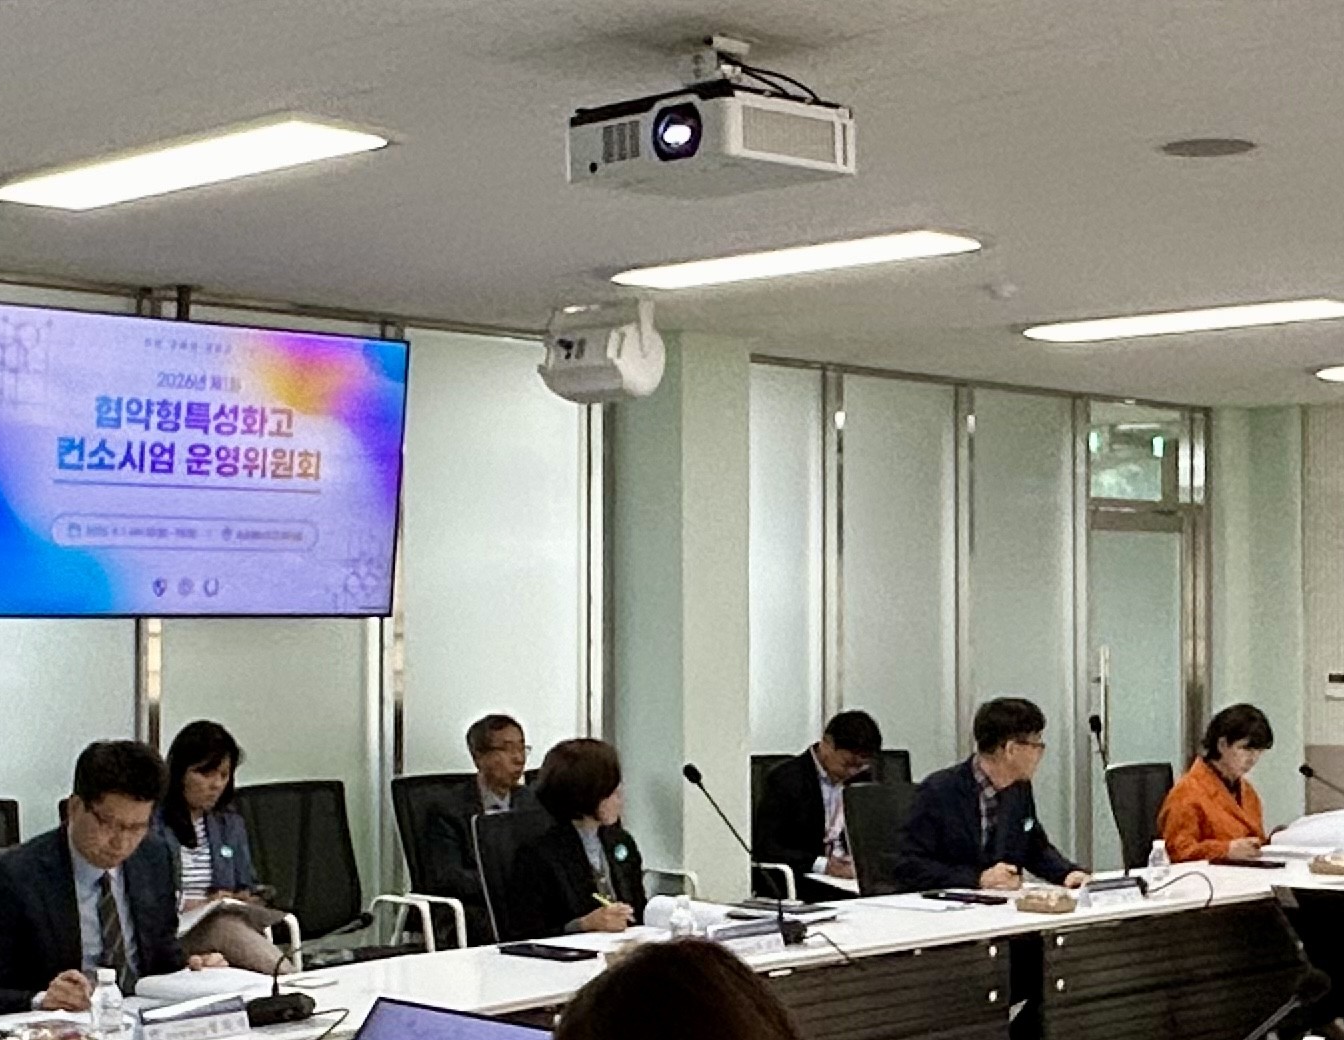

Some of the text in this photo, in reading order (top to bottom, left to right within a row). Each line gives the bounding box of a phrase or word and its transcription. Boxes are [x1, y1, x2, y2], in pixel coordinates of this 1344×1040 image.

[94, 395, 294, 438] 협약형특성화고
[56, 436, 322, 482] 컨소시엄 운영위원회
